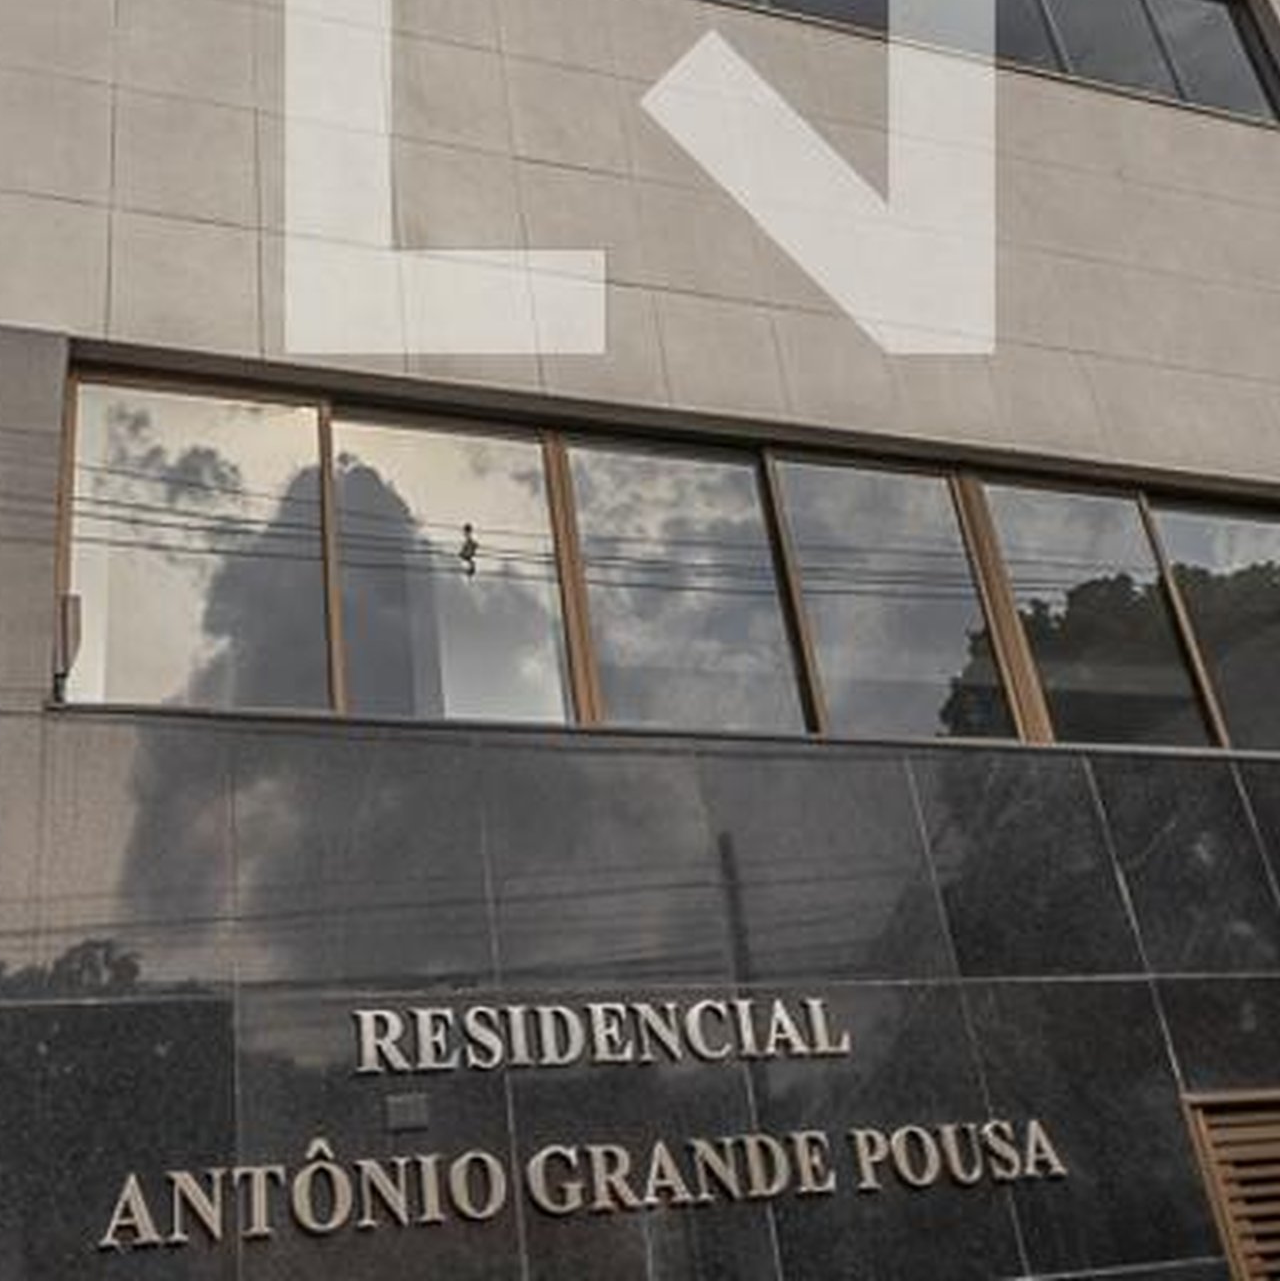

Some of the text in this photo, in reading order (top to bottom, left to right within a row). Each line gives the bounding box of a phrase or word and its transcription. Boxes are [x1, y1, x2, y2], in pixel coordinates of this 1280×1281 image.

[354, 998, 851, 1072] RESIDENCIAL
[99, 1120, 1066, 1247] ANTÔNIO GRANDE POUSA
